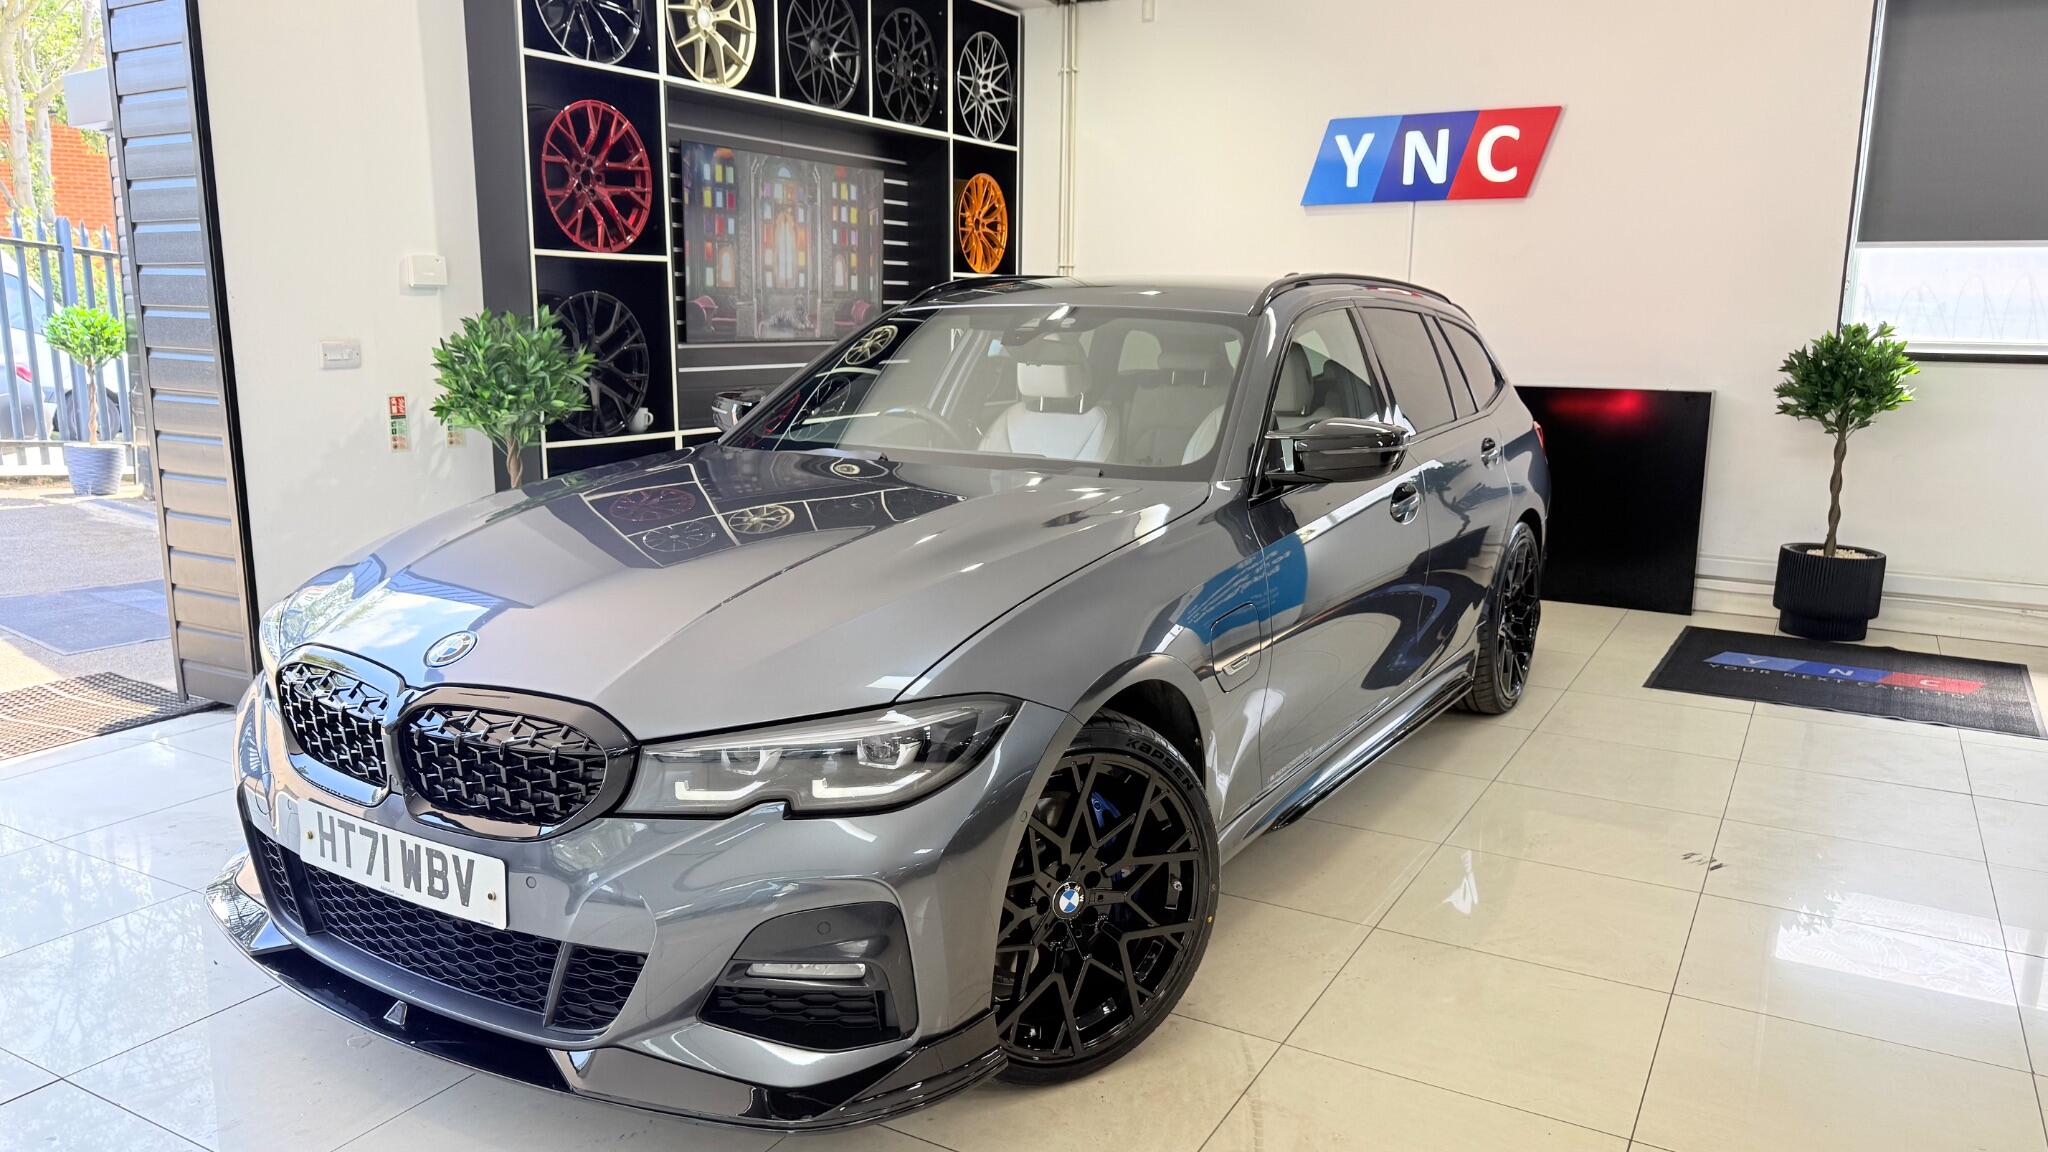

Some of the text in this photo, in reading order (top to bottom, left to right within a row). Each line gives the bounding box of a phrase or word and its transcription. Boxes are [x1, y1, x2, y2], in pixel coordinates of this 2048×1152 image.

[1334, 124, 1521, 188] YNC
[1708, 662, 1771, 675] YOUR
[1783, 672, 1845, 684] NEXT
[316, 810, 475, 907] HT71 WBV
